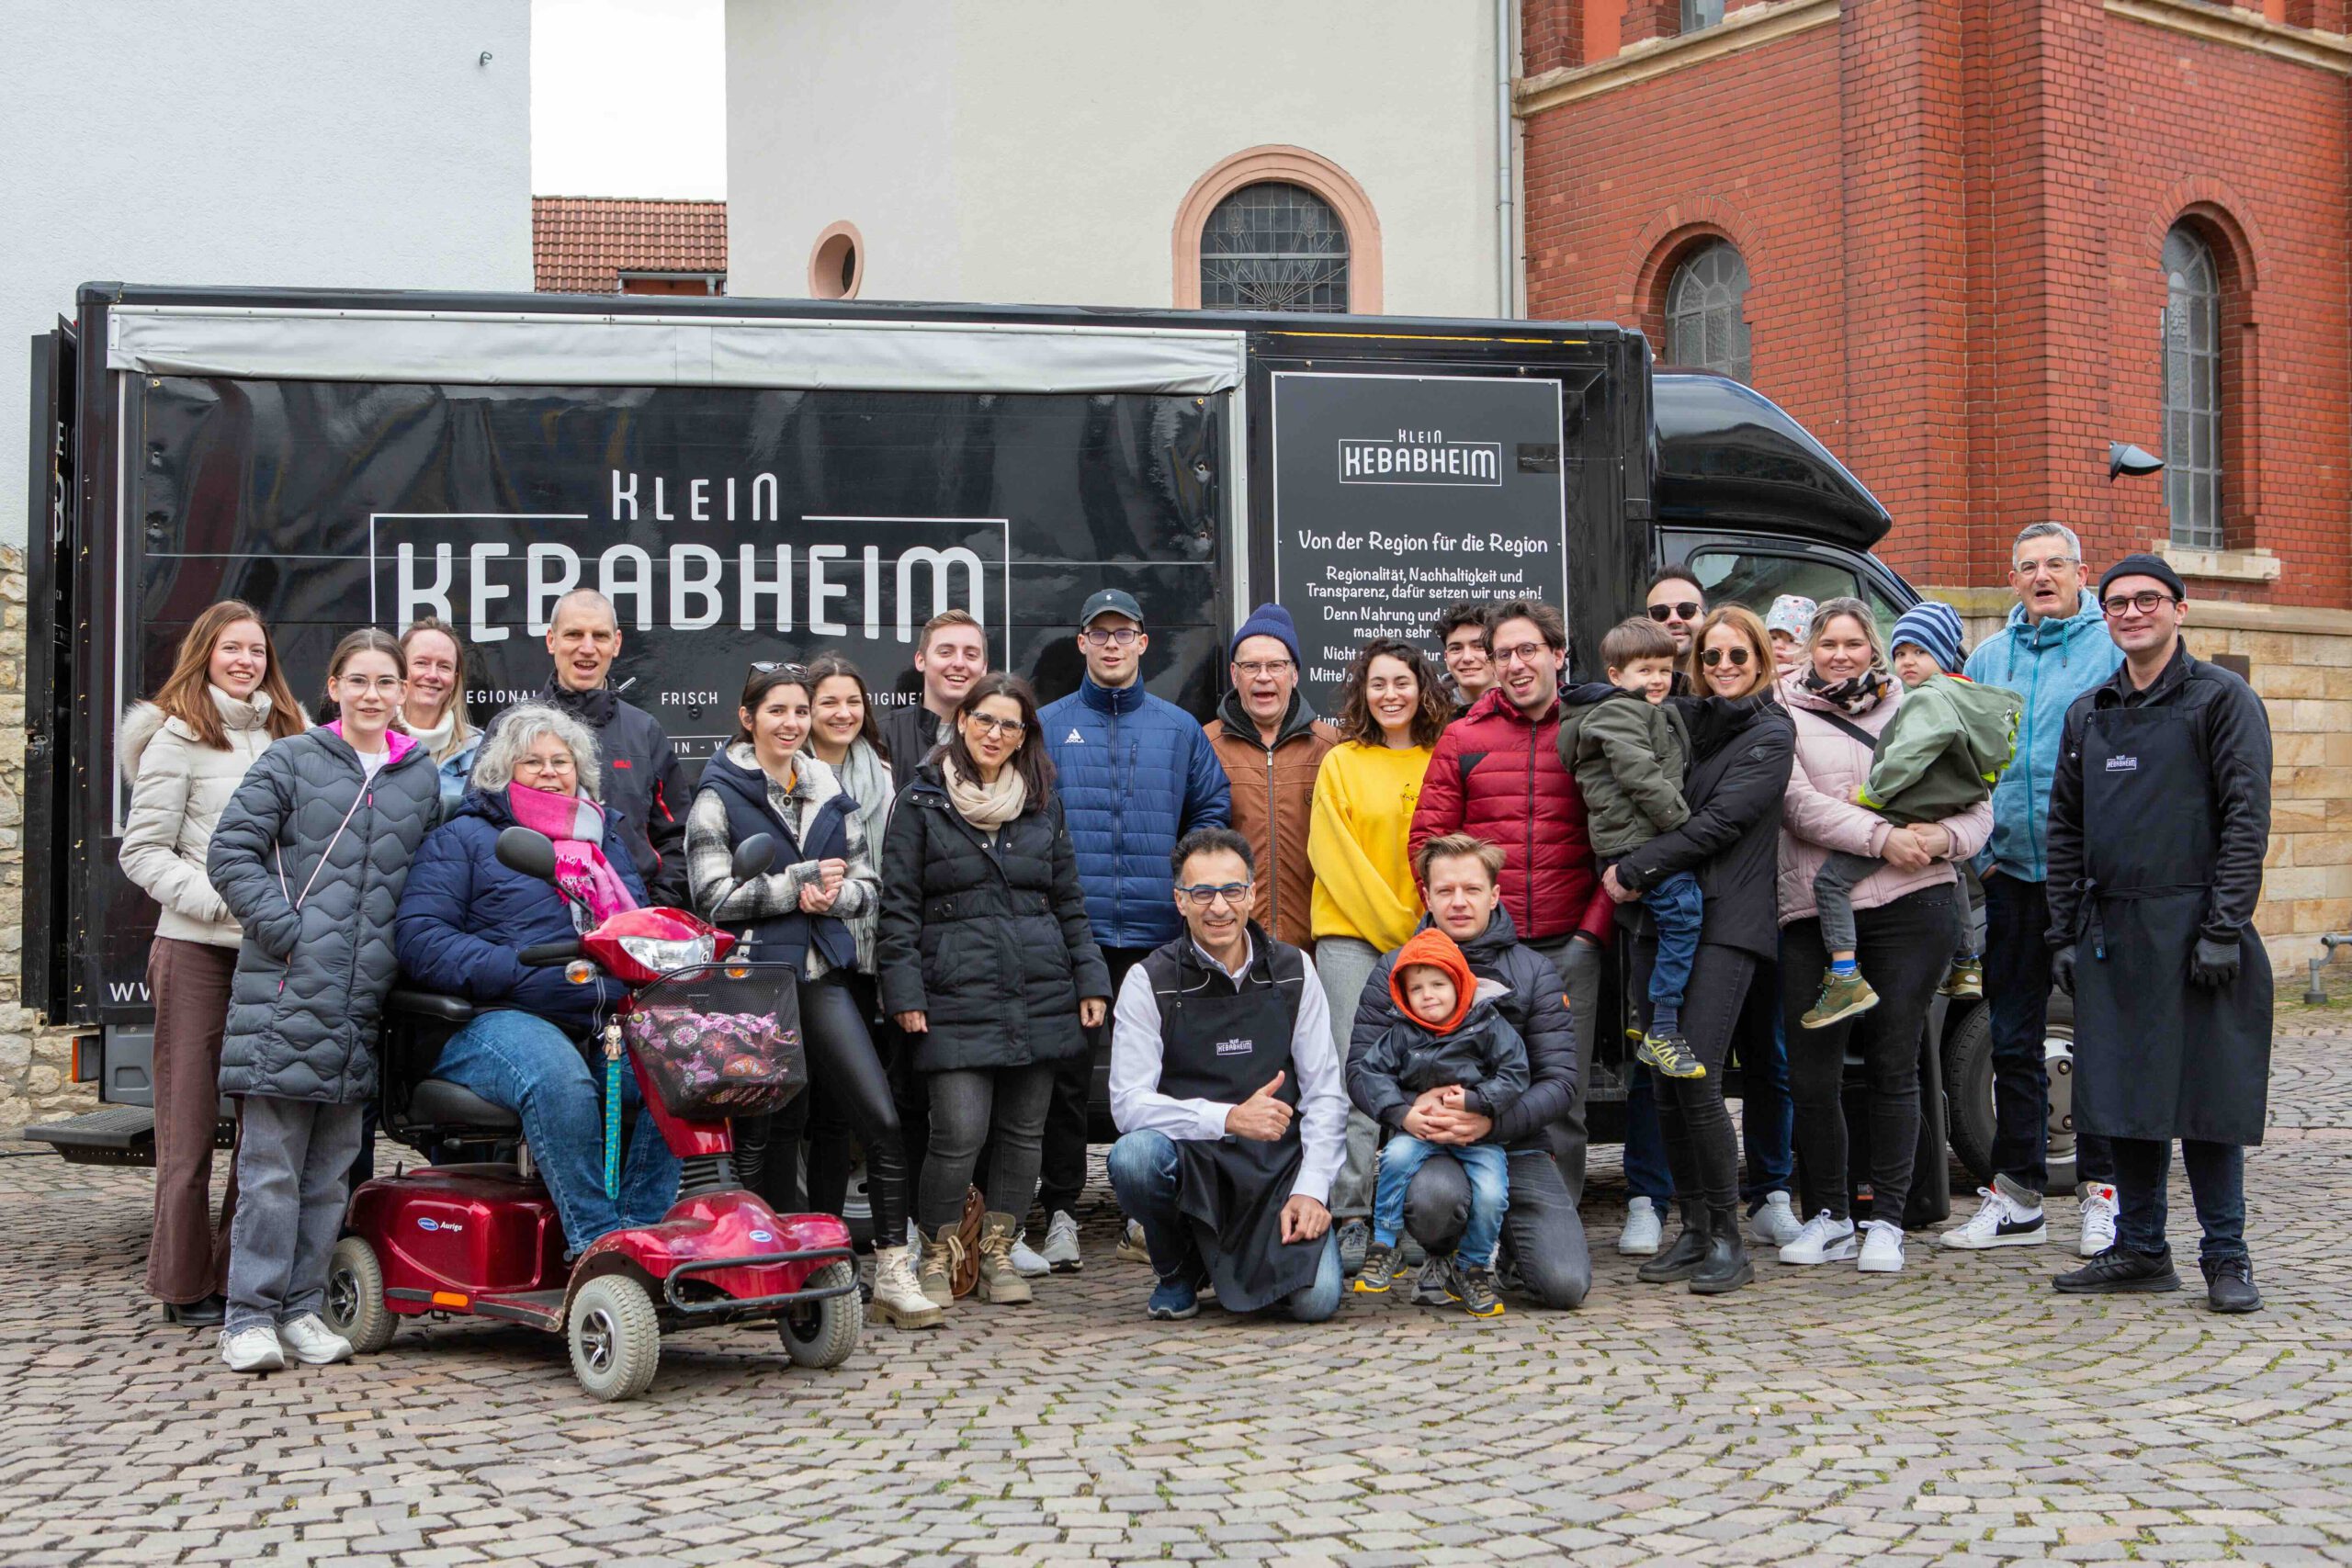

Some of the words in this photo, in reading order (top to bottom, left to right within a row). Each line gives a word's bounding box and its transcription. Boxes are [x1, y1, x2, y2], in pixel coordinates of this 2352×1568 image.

[1397, 428, 1442, 444] KLEIN
[1344, 446, 1496, 479] KEBABHEIM
[612, 469, 779, 522] KLEIN
[1298, 529, 1332, 550] Von
[1336, 530, 1363, 550] der
[1368, 530, 1429, 557] Region
[1431, 532, 1458, 551] für
[1461, 532, 1485, 552] die
[1488, 533, 1548, 558] Region
[1326, 565, 1407, 585] Regionalität,
[1408, 567, 1498, 586] Nachhaltigkeit
[1499, 568, 1523, 583] und
[397, 542, 985, 644] KEBABHEIM
[1306, 582, 1389, 603] Transparenz,
[1391, 583, 1425, 599] dafür
[1428, 586, 1469, 600] setzen
[1471, 586, 1490, 600] wir
[1493, 589, 1516, 600] uns
[1519, 585, 1543, 600] ein!
[1323, 605, 1358, 621] Denn
[1360, 606, 1416, 626] Nahrung
[1418, 606, 1441, 622] und
[1353, 624, 1402, 639] machen
[1405, 624, 1432, 639] sehr
[1323, 646, 1357, 661] Nicht
[466, 689, 537, 704] EGIONA
[661, 691, 718, 705] FRISCH
